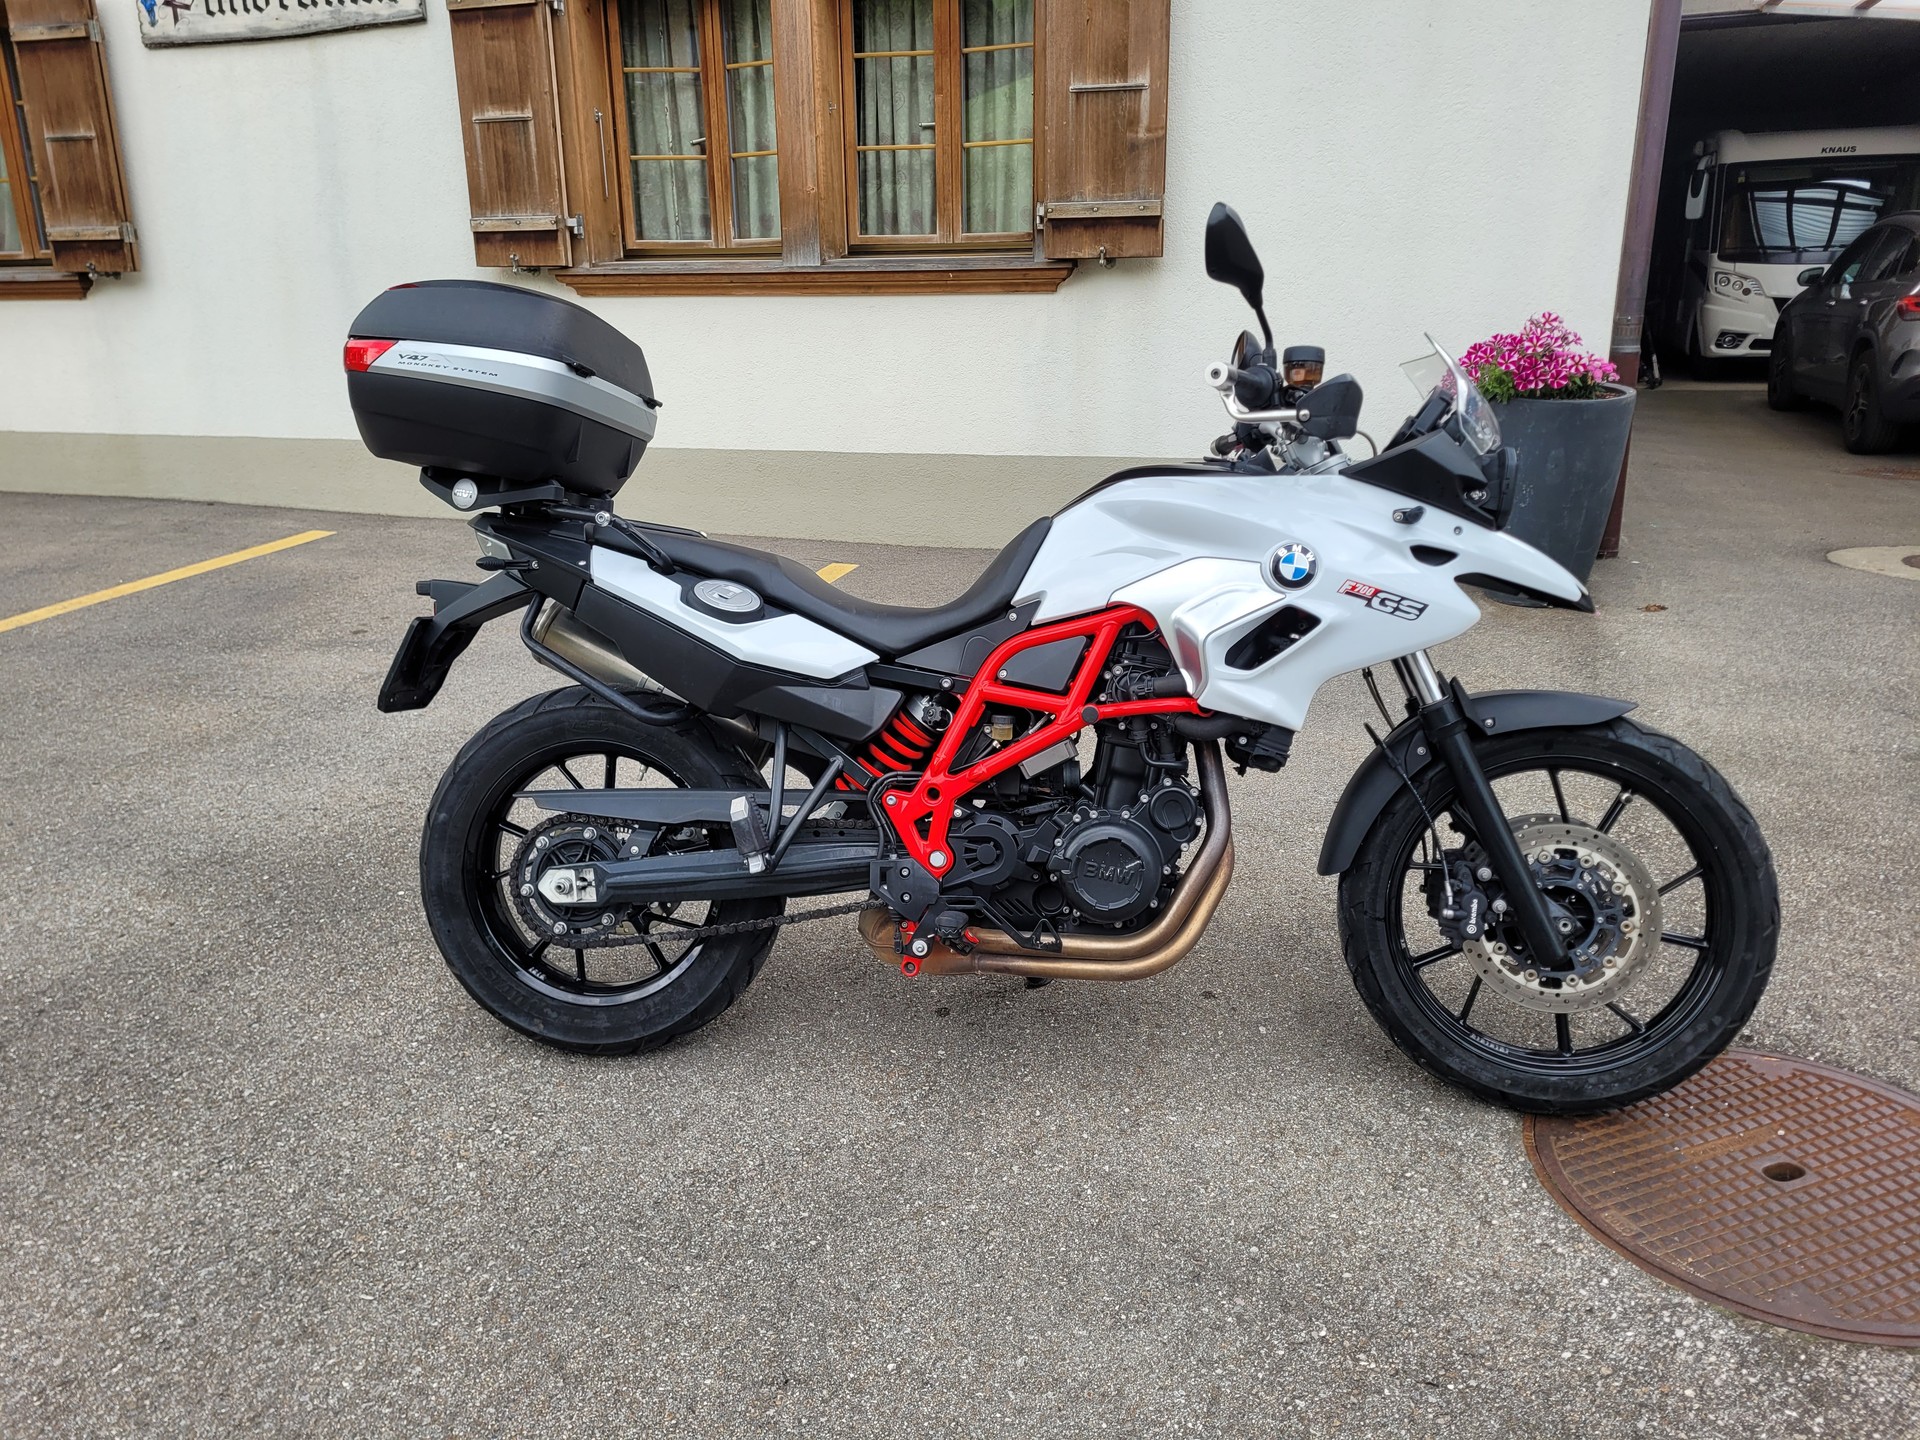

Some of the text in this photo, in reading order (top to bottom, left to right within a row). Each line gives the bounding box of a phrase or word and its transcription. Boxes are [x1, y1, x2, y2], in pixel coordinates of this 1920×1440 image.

[1820, 145, 1857, 154] KNAUS
[397, 361, 498, 377] MONOKEY SYSTEM
[1277, 543, 1316, 562] BMW
[1083, 860, 1135, 886] BMW
[1468, 898, 1478, 925] brembo
